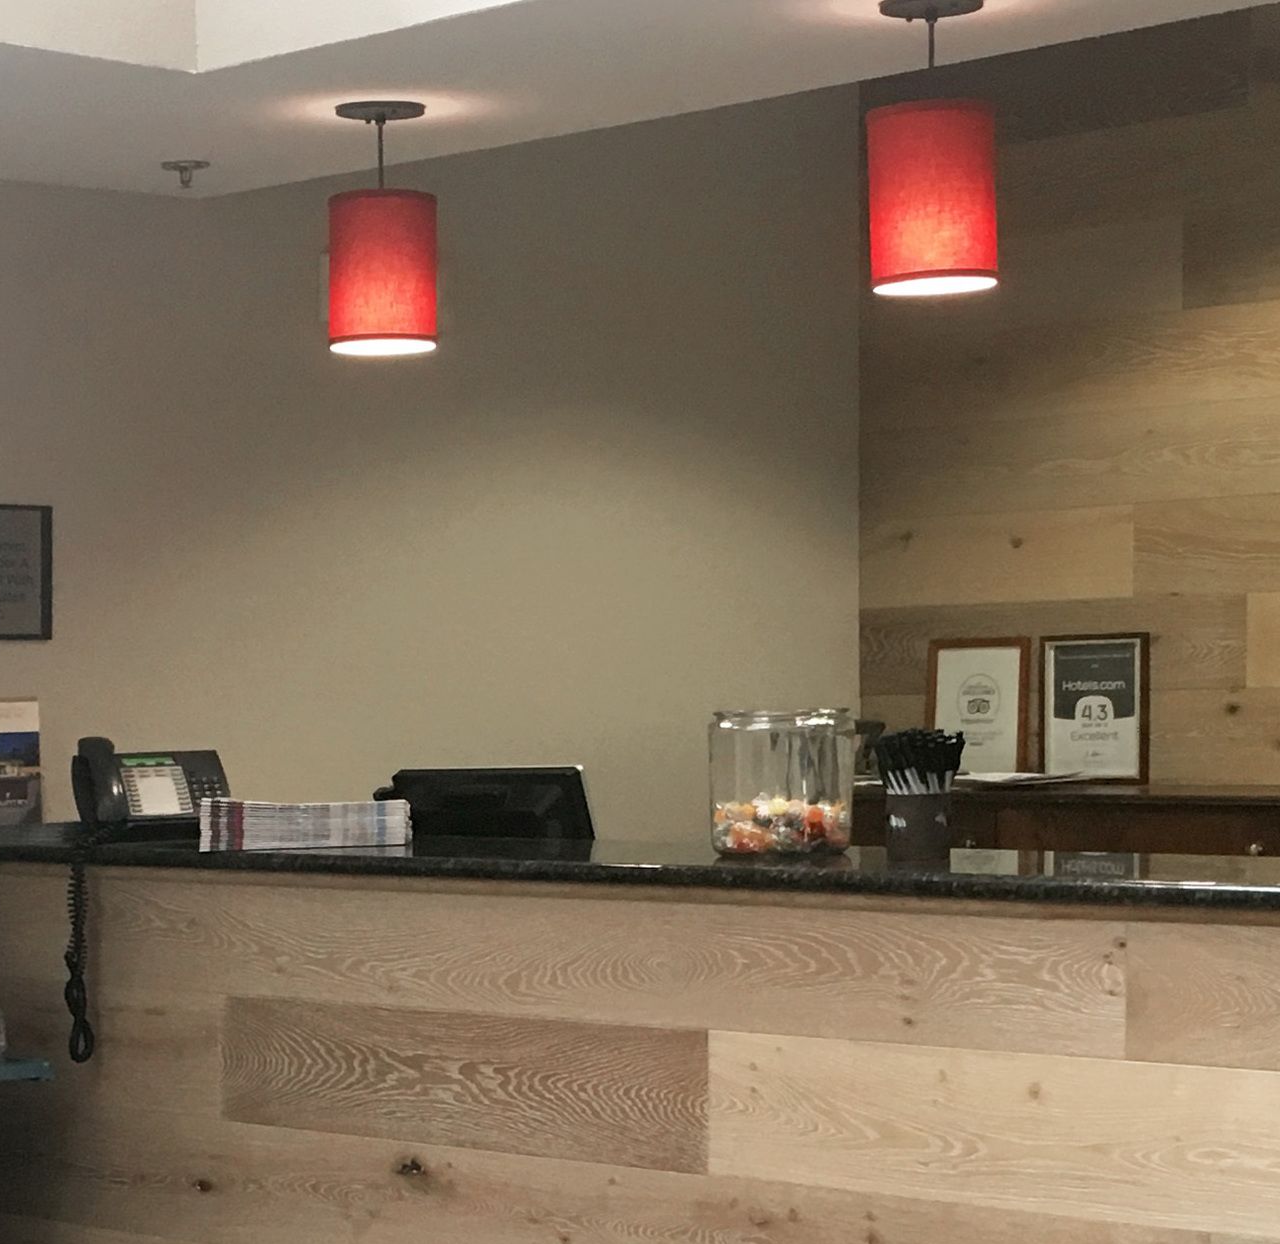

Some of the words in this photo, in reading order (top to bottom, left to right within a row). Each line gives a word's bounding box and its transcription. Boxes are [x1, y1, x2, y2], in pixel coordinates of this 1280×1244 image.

[1062, 680, 1126, 691] Hotels.com
[1081, 704, 1108, 721] 4.3
[1070, 730, 1118, 740] Excellent
